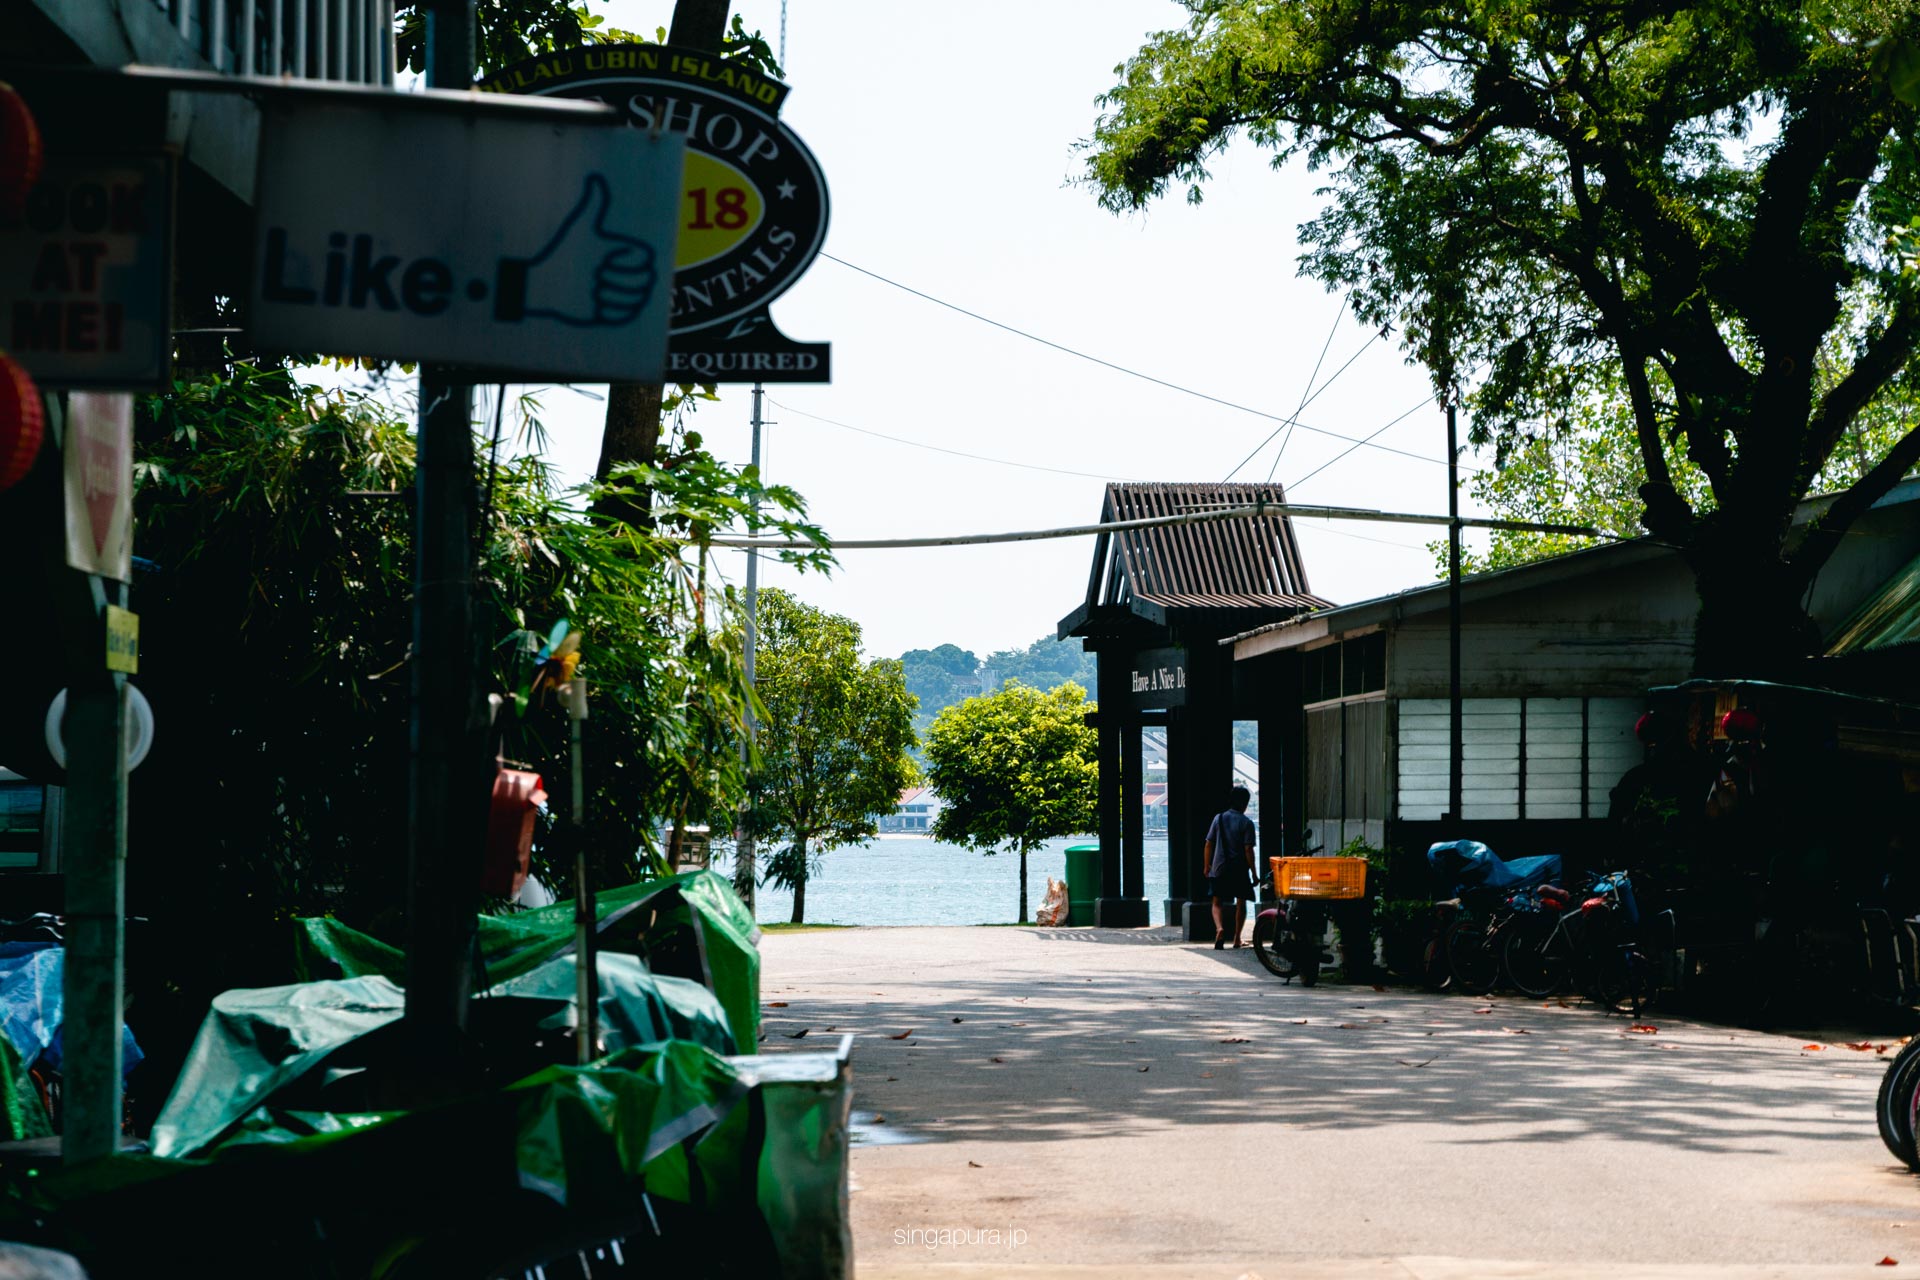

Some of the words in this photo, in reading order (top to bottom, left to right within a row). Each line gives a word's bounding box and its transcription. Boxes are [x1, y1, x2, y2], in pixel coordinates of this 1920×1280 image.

[584, 51, 659, 71] UBIN
[671, 54, 779, 105] ISLAND
[626, 94, 780, 166] SHOP
[14, 180, 149, 233] OOK
[687, 188, 749, 229] 18
[32, 240, 108, 292] AT
[669, 225, 797, 317] ENTALS
[668, 352, 818, 376] EQUIRED
[1131, 670, 1149, 692] Have
[1151, 668, 1158, 690] A
[1159, 667, 1175, 690] Nice
